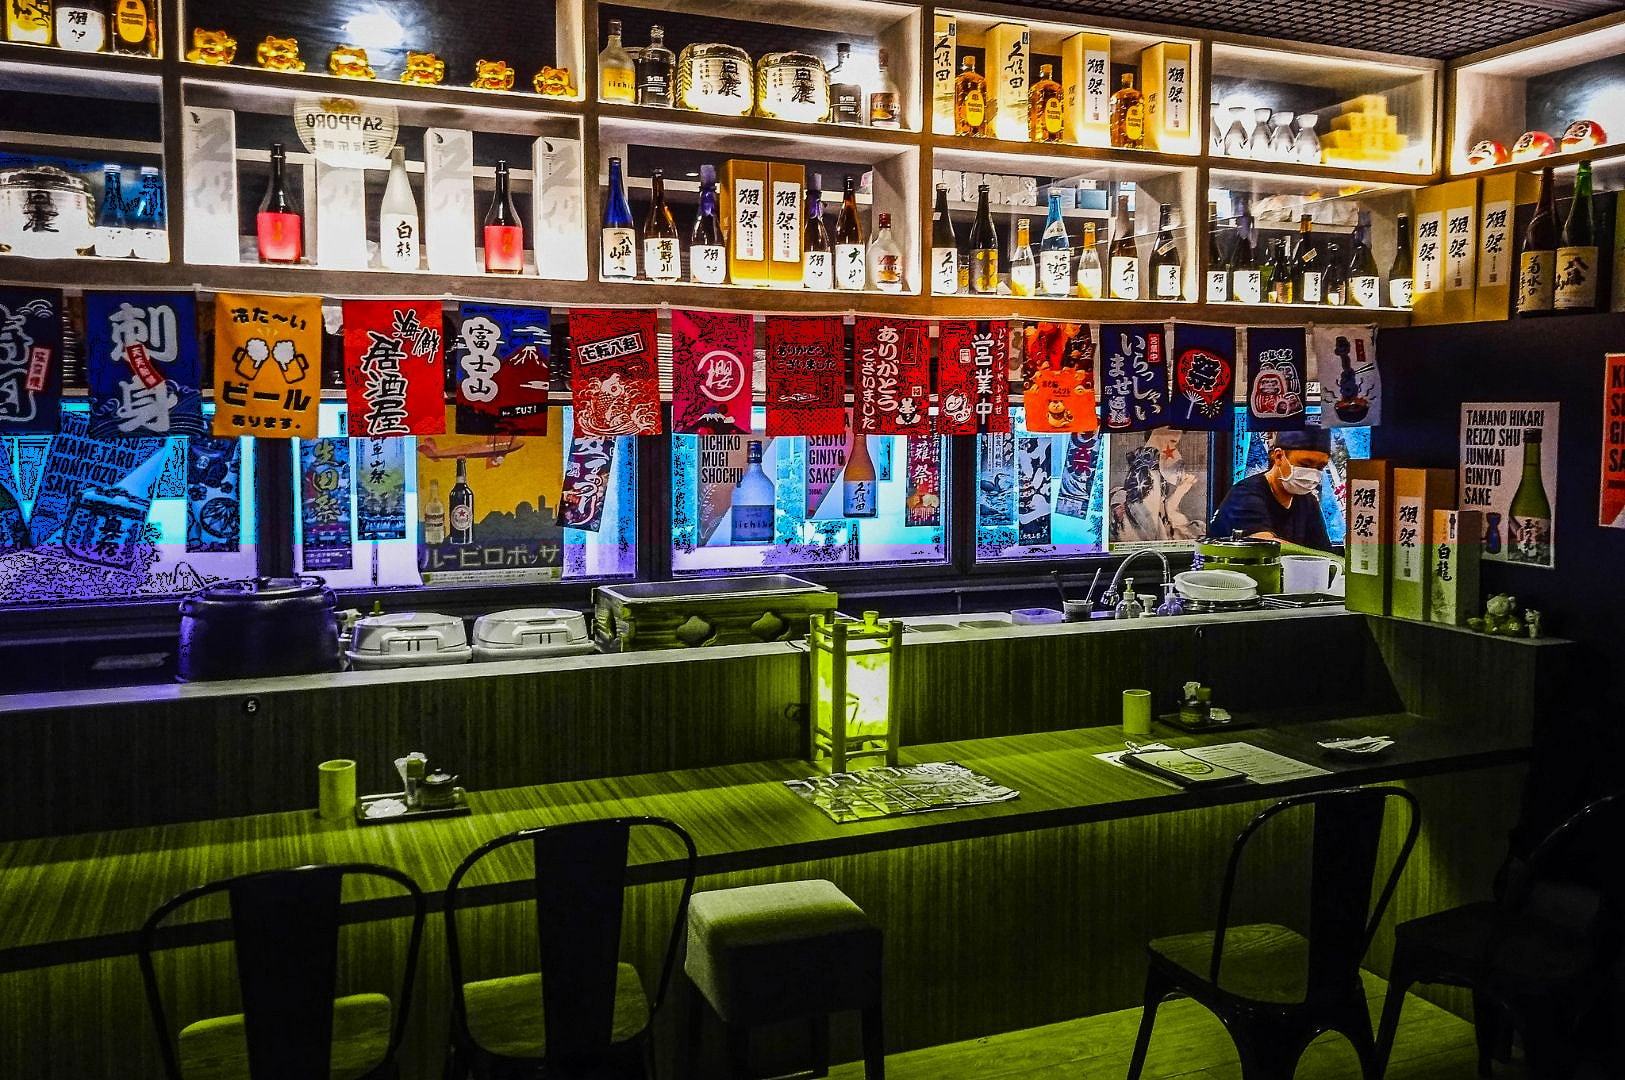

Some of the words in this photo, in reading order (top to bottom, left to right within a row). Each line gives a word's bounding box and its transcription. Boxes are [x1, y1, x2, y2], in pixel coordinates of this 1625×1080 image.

[1004, 41, 1025, 88] 久保田
[1088, 59, 1106, 94] 獺祭
[1168, 67, 1184, 103] 獺祭
[738, 188, 760, 229] 獺祭
[775, 190, 798, 231] 獺祭
[1418, 220, 1439, 262] 獺祭
[1448, 215, 1470, 259] 獺祭
[1484, 209, 1507, 253] 獺祭
[392, 309, 442, 364] 海鮮
[582, 336, 638, 361] 七転八起
[108, 302, 179, 432] 刺身
[468, 323, 495, 396] 富士山
[876, 325, 900, 412] ありがとう
[971, 332, 995, 425] 営業中
[995, 327, 1007, 415] いらっしゃいませ
[222, 381, 311, 412] ビール
[360, 330, 411, 436] 居酒屋
[860, 347, 877, 431] ございました
[231, 414, 302, 430] あります。
[1466, 409, 1507, 427] TAMANO
[1509, 409, 1545, 427] HIKARI
[1466, 427, 1496, 446] REIZO
[1498, 428, 1521, 447] SHU
[701, 436, 741, 451] IICHIKO
[701, 452, 729, 468] MUGI
[809, 449, 845, 466] GINJYO
[1465, 447, 1505, 467] JUNMAI
[701, 467, 743, 484] SHOCHU
[808, 468, 836, 484] SAKE
[1464, 466, 1503, 487] GINJYO
[852, 481, 866, 511] 久保田
[1353, 487, 1377, 538] 獺祭
[1463, 486, 1492, 506] SAKE
[1398, 505, 1419, 549] 獺祭
[1436, 542, 1453, 582] 白龍
[247, 700, 257, 712] 5
